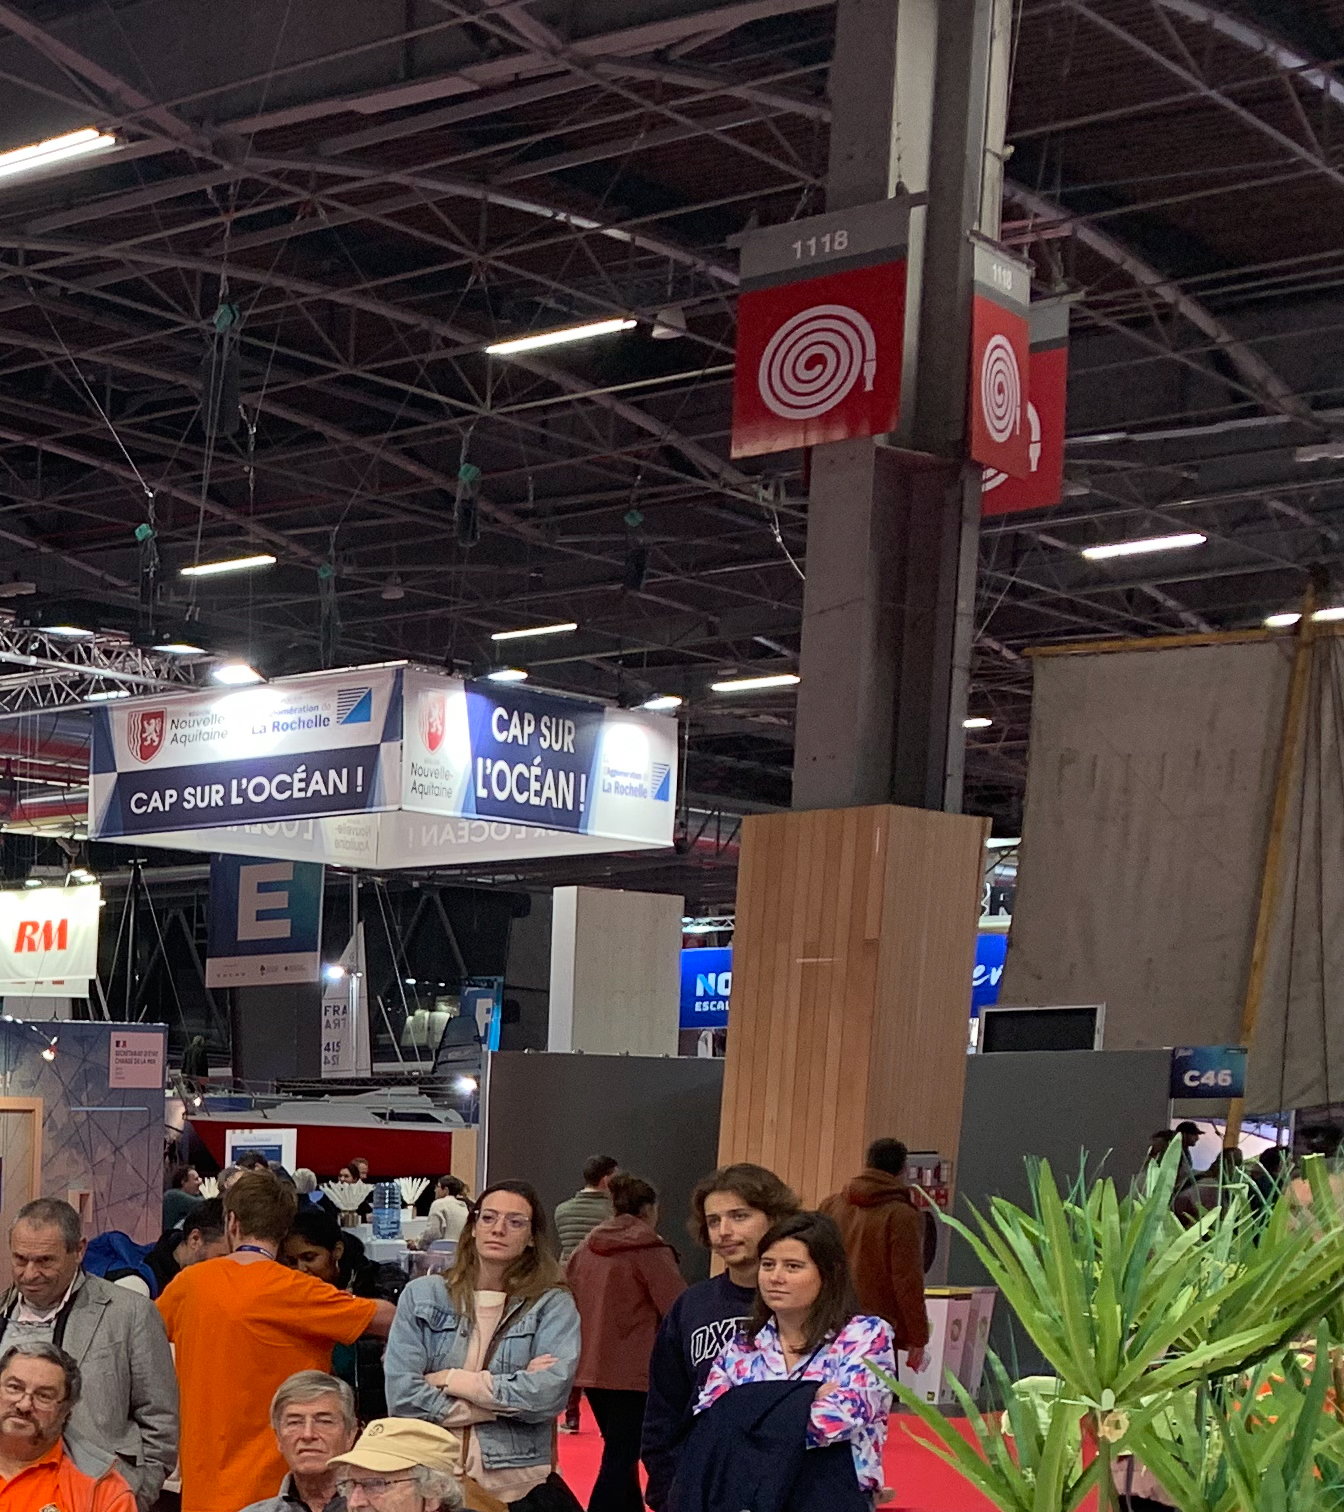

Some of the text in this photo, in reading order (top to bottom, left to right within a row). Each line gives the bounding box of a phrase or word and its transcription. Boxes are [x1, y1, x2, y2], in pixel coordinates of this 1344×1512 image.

[792, 230, 848, 259] 1118
[993, 263, 1013, 290] 1118
[272, 714, 330, 733] Rochelle
[491, 706, 575, 754] CAP SUR
[170, 728, 229, 747] Aquitaine
[130, 764, 363, 815] CAP SUR L'OCÉAN !
[410, 780, 453, 800] Aquitaine
[476, 755, 587, 812] L'OCÉAN !
[602, 779, 648, 800] La Rochelle
[237, 861, 294, 941] E
[14, 918, 69, 954] RM
[6, 1070, 11, 1088] !
[1183, 1069, 1233, 1088] C46
